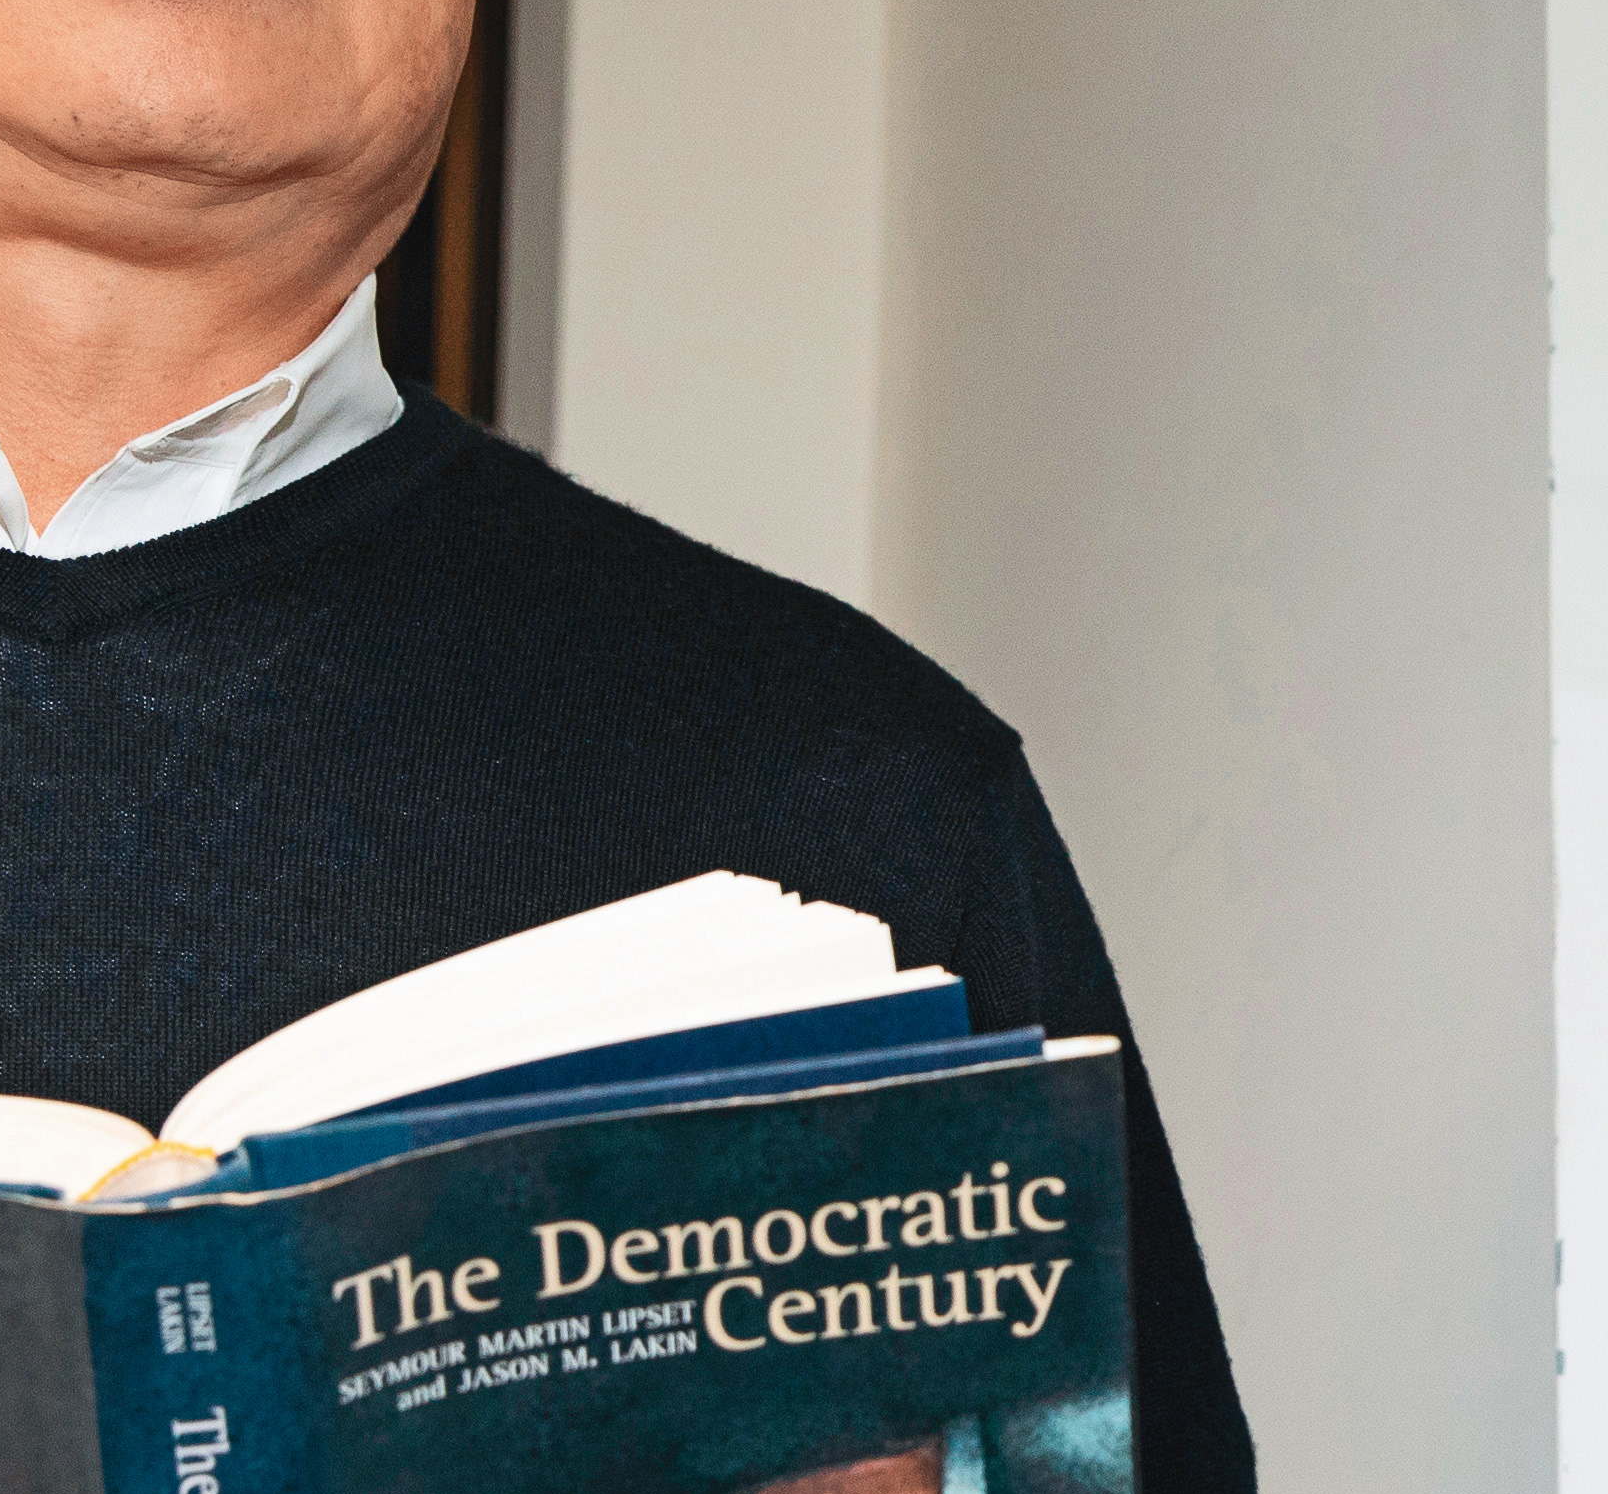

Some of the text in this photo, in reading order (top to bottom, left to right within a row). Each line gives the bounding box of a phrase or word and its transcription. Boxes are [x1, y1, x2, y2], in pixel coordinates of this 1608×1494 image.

[333, 1160, 1069, 1351] The Democratic
[156, 1286, 186, 1355] LAKIN
[185, 1282, 217, 1353] LIPSET
[704, 1257, 1073, 1354] Century
[337, 1299, 698, 1406] SEYMOUR MARTIN LIPSET
[396, 1329, 699, 1412] and JASON M. LAKIN
